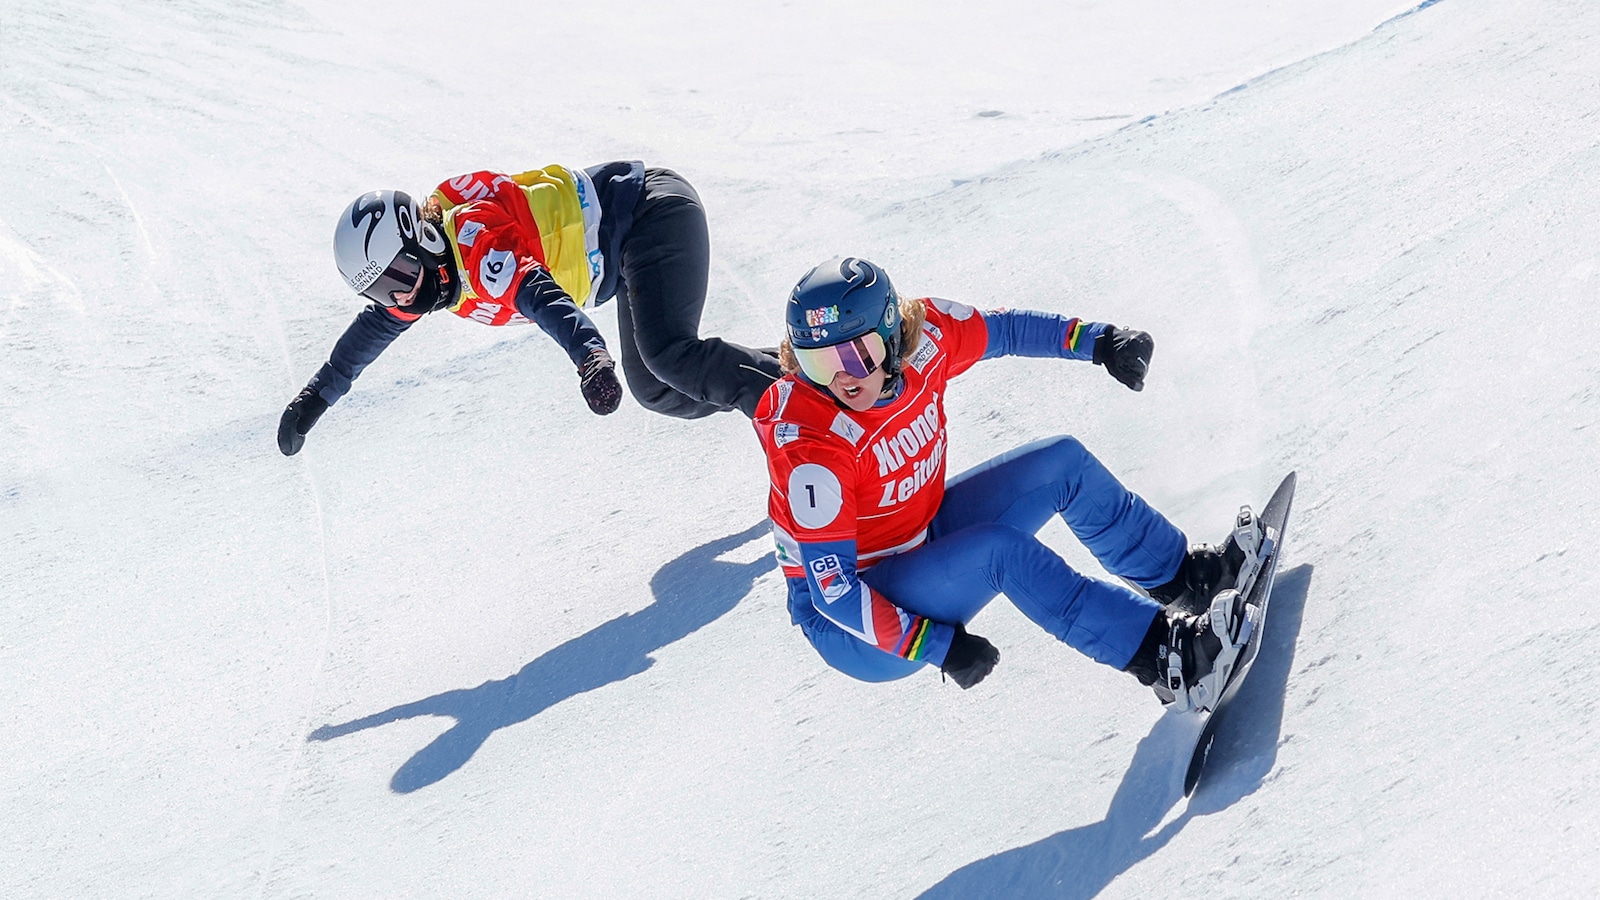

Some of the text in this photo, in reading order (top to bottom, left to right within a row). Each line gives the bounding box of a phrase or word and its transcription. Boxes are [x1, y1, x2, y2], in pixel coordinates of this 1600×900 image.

[354, 260, 378, 281] GRAND
[485, 261, 504, 283] 16
[872, 391, 939, 478] Krone
[878, 429, 945, 507] Zeitun
[805, 484, 816, 508] 1
[812, 555, 838, 574] GB
